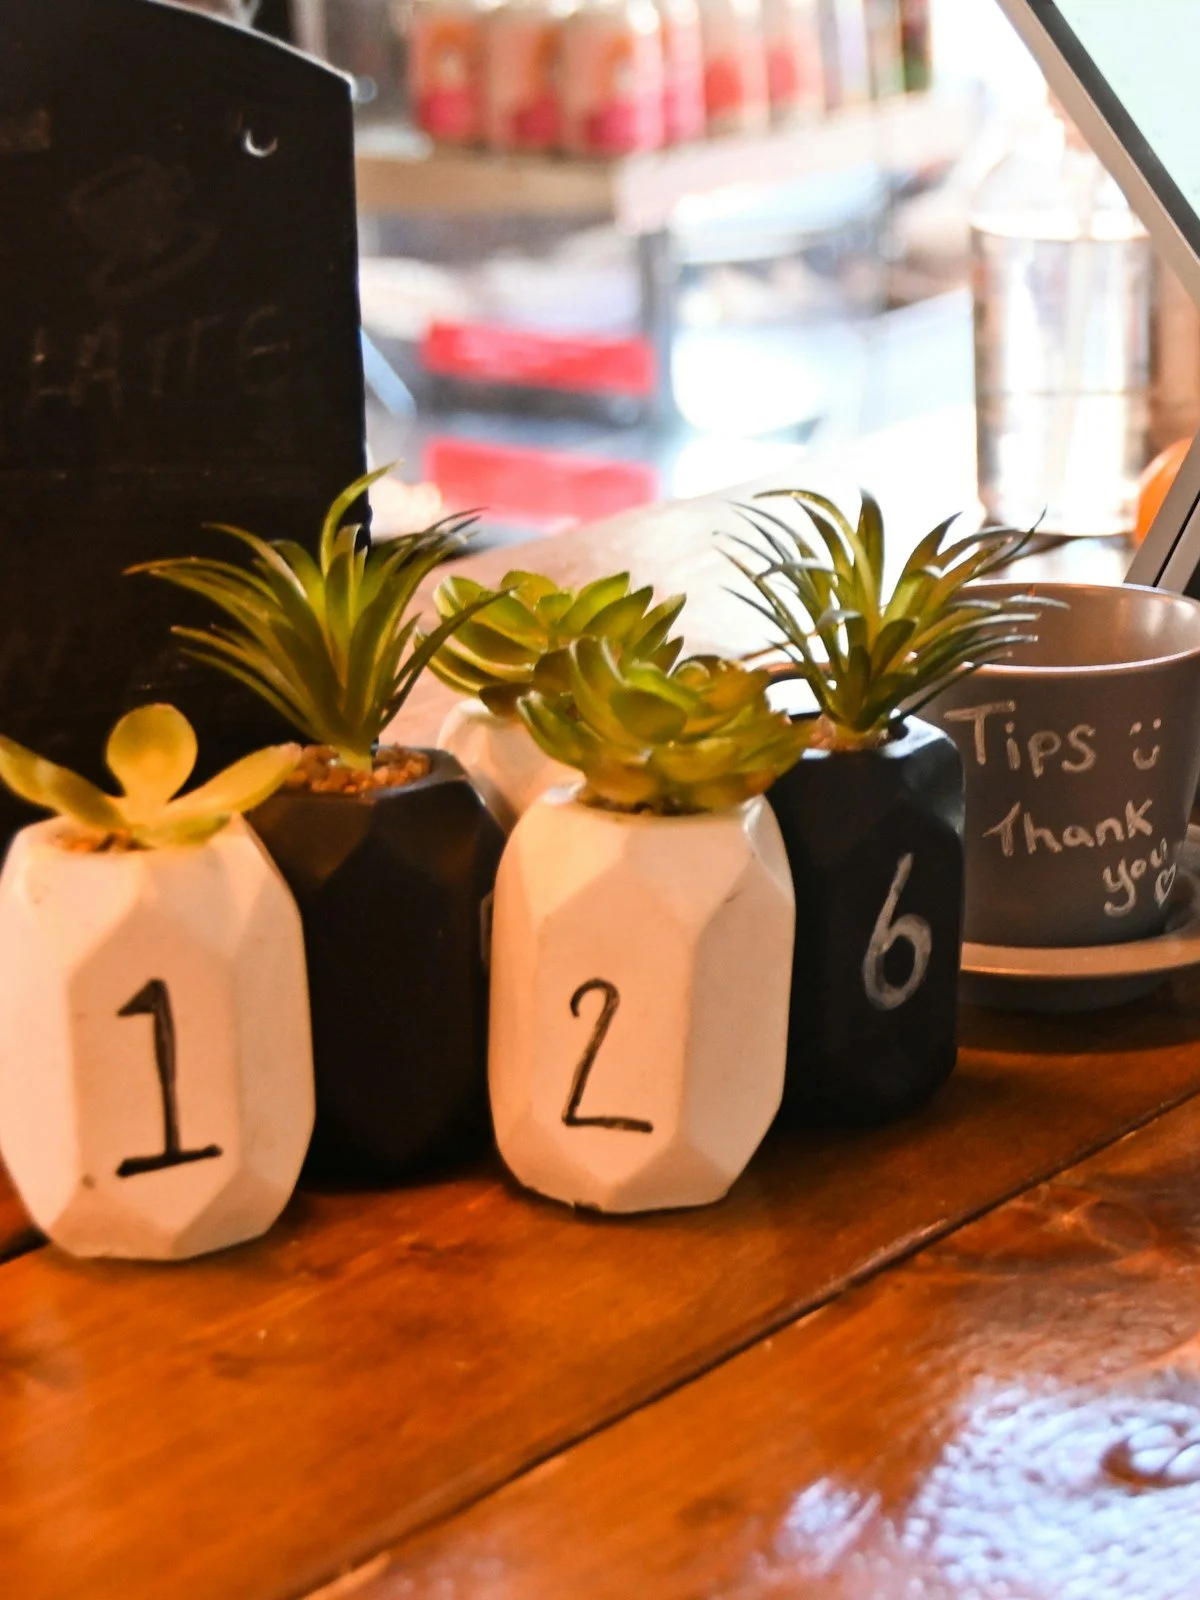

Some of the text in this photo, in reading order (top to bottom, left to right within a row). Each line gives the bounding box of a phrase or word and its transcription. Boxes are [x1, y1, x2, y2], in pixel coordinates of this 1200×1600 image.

[943, 700, 1096, 778] Tips
[983, 800, 1153, 857] Thank
[1102, 838, 1168, 917] you
[864, 854, 931, 1009] 6
[117, 978, 222, 1177] 1
[563, 977, 653, 1134] 2
